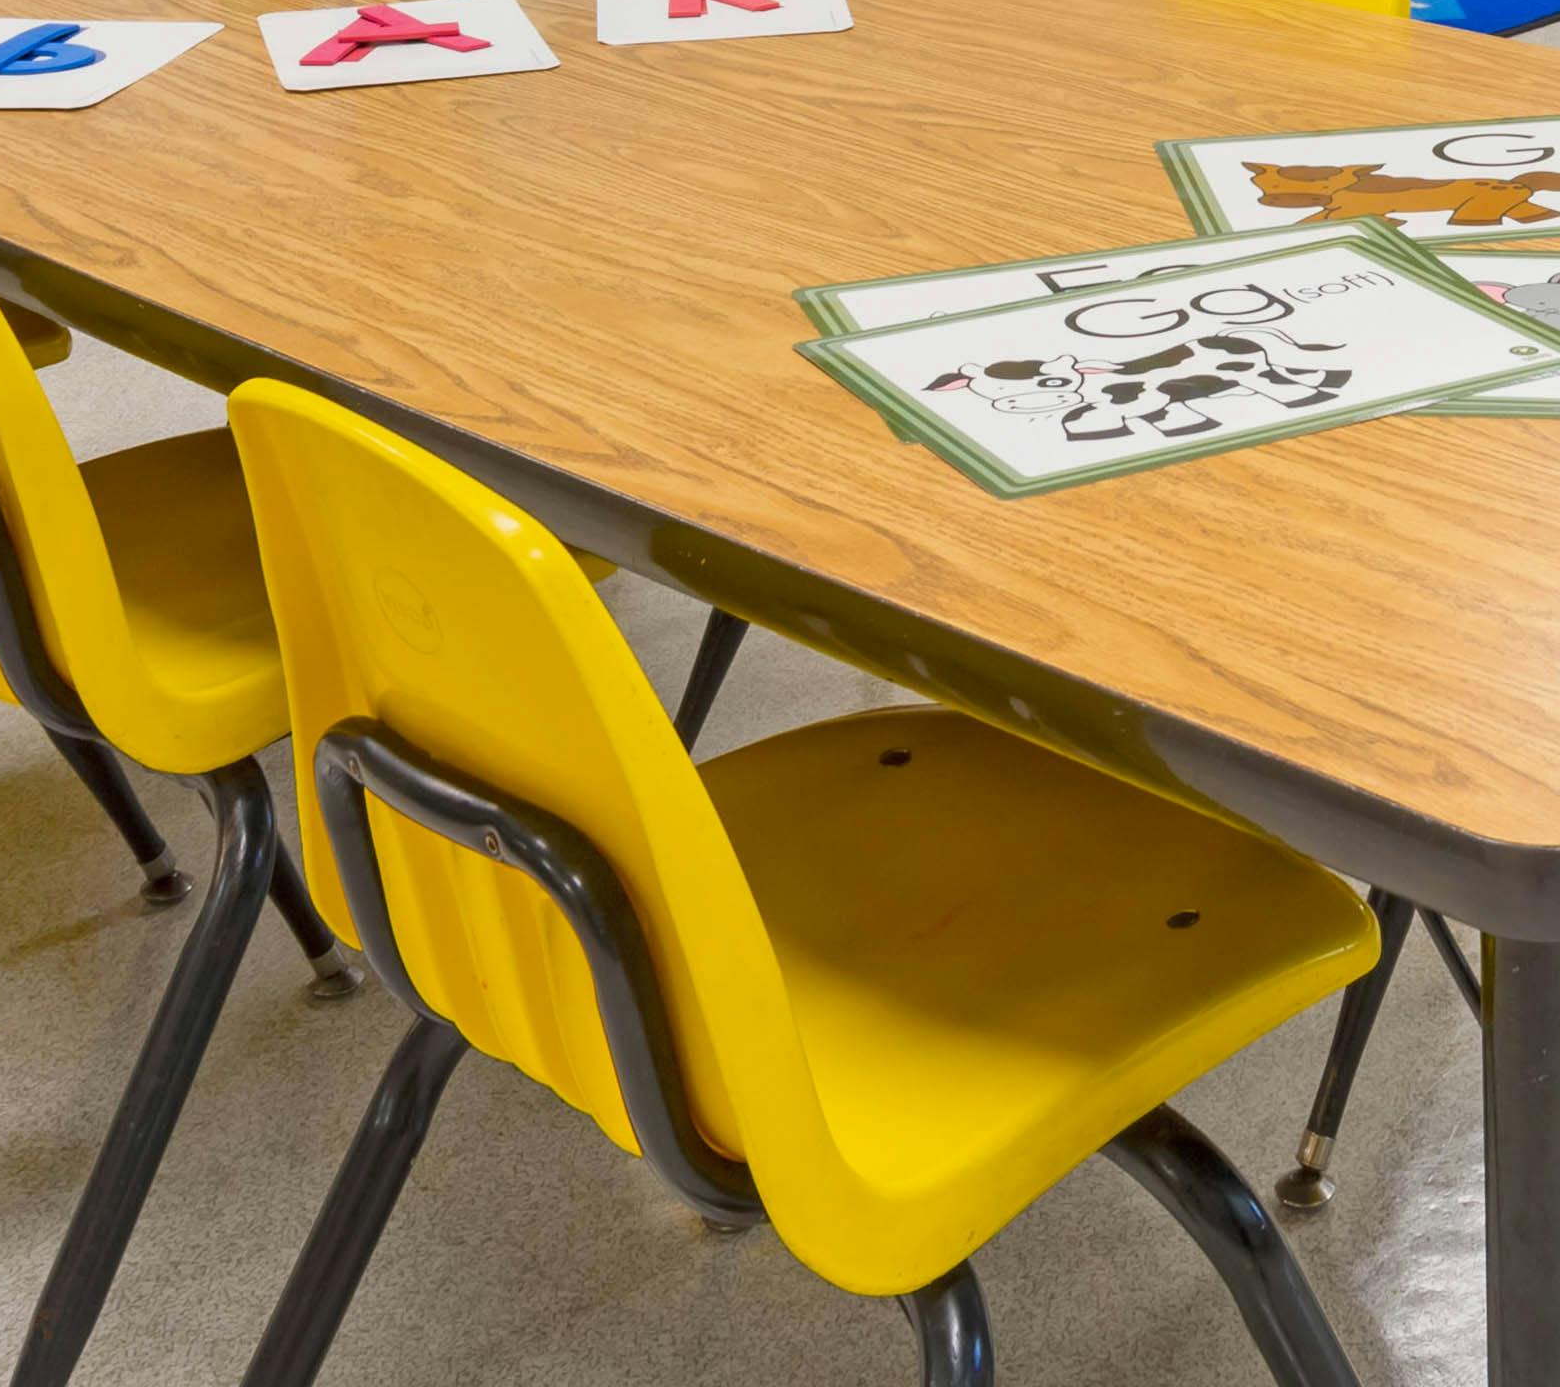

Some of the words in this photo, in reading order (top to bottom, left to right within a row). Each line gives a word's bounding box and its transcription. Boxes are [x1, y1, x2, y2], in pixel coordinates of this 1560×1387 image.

[299, 4, 491, 66] A
[1064, 284, 1295, 338] Gg
[1283, 271, 1394, 303] (soft)
